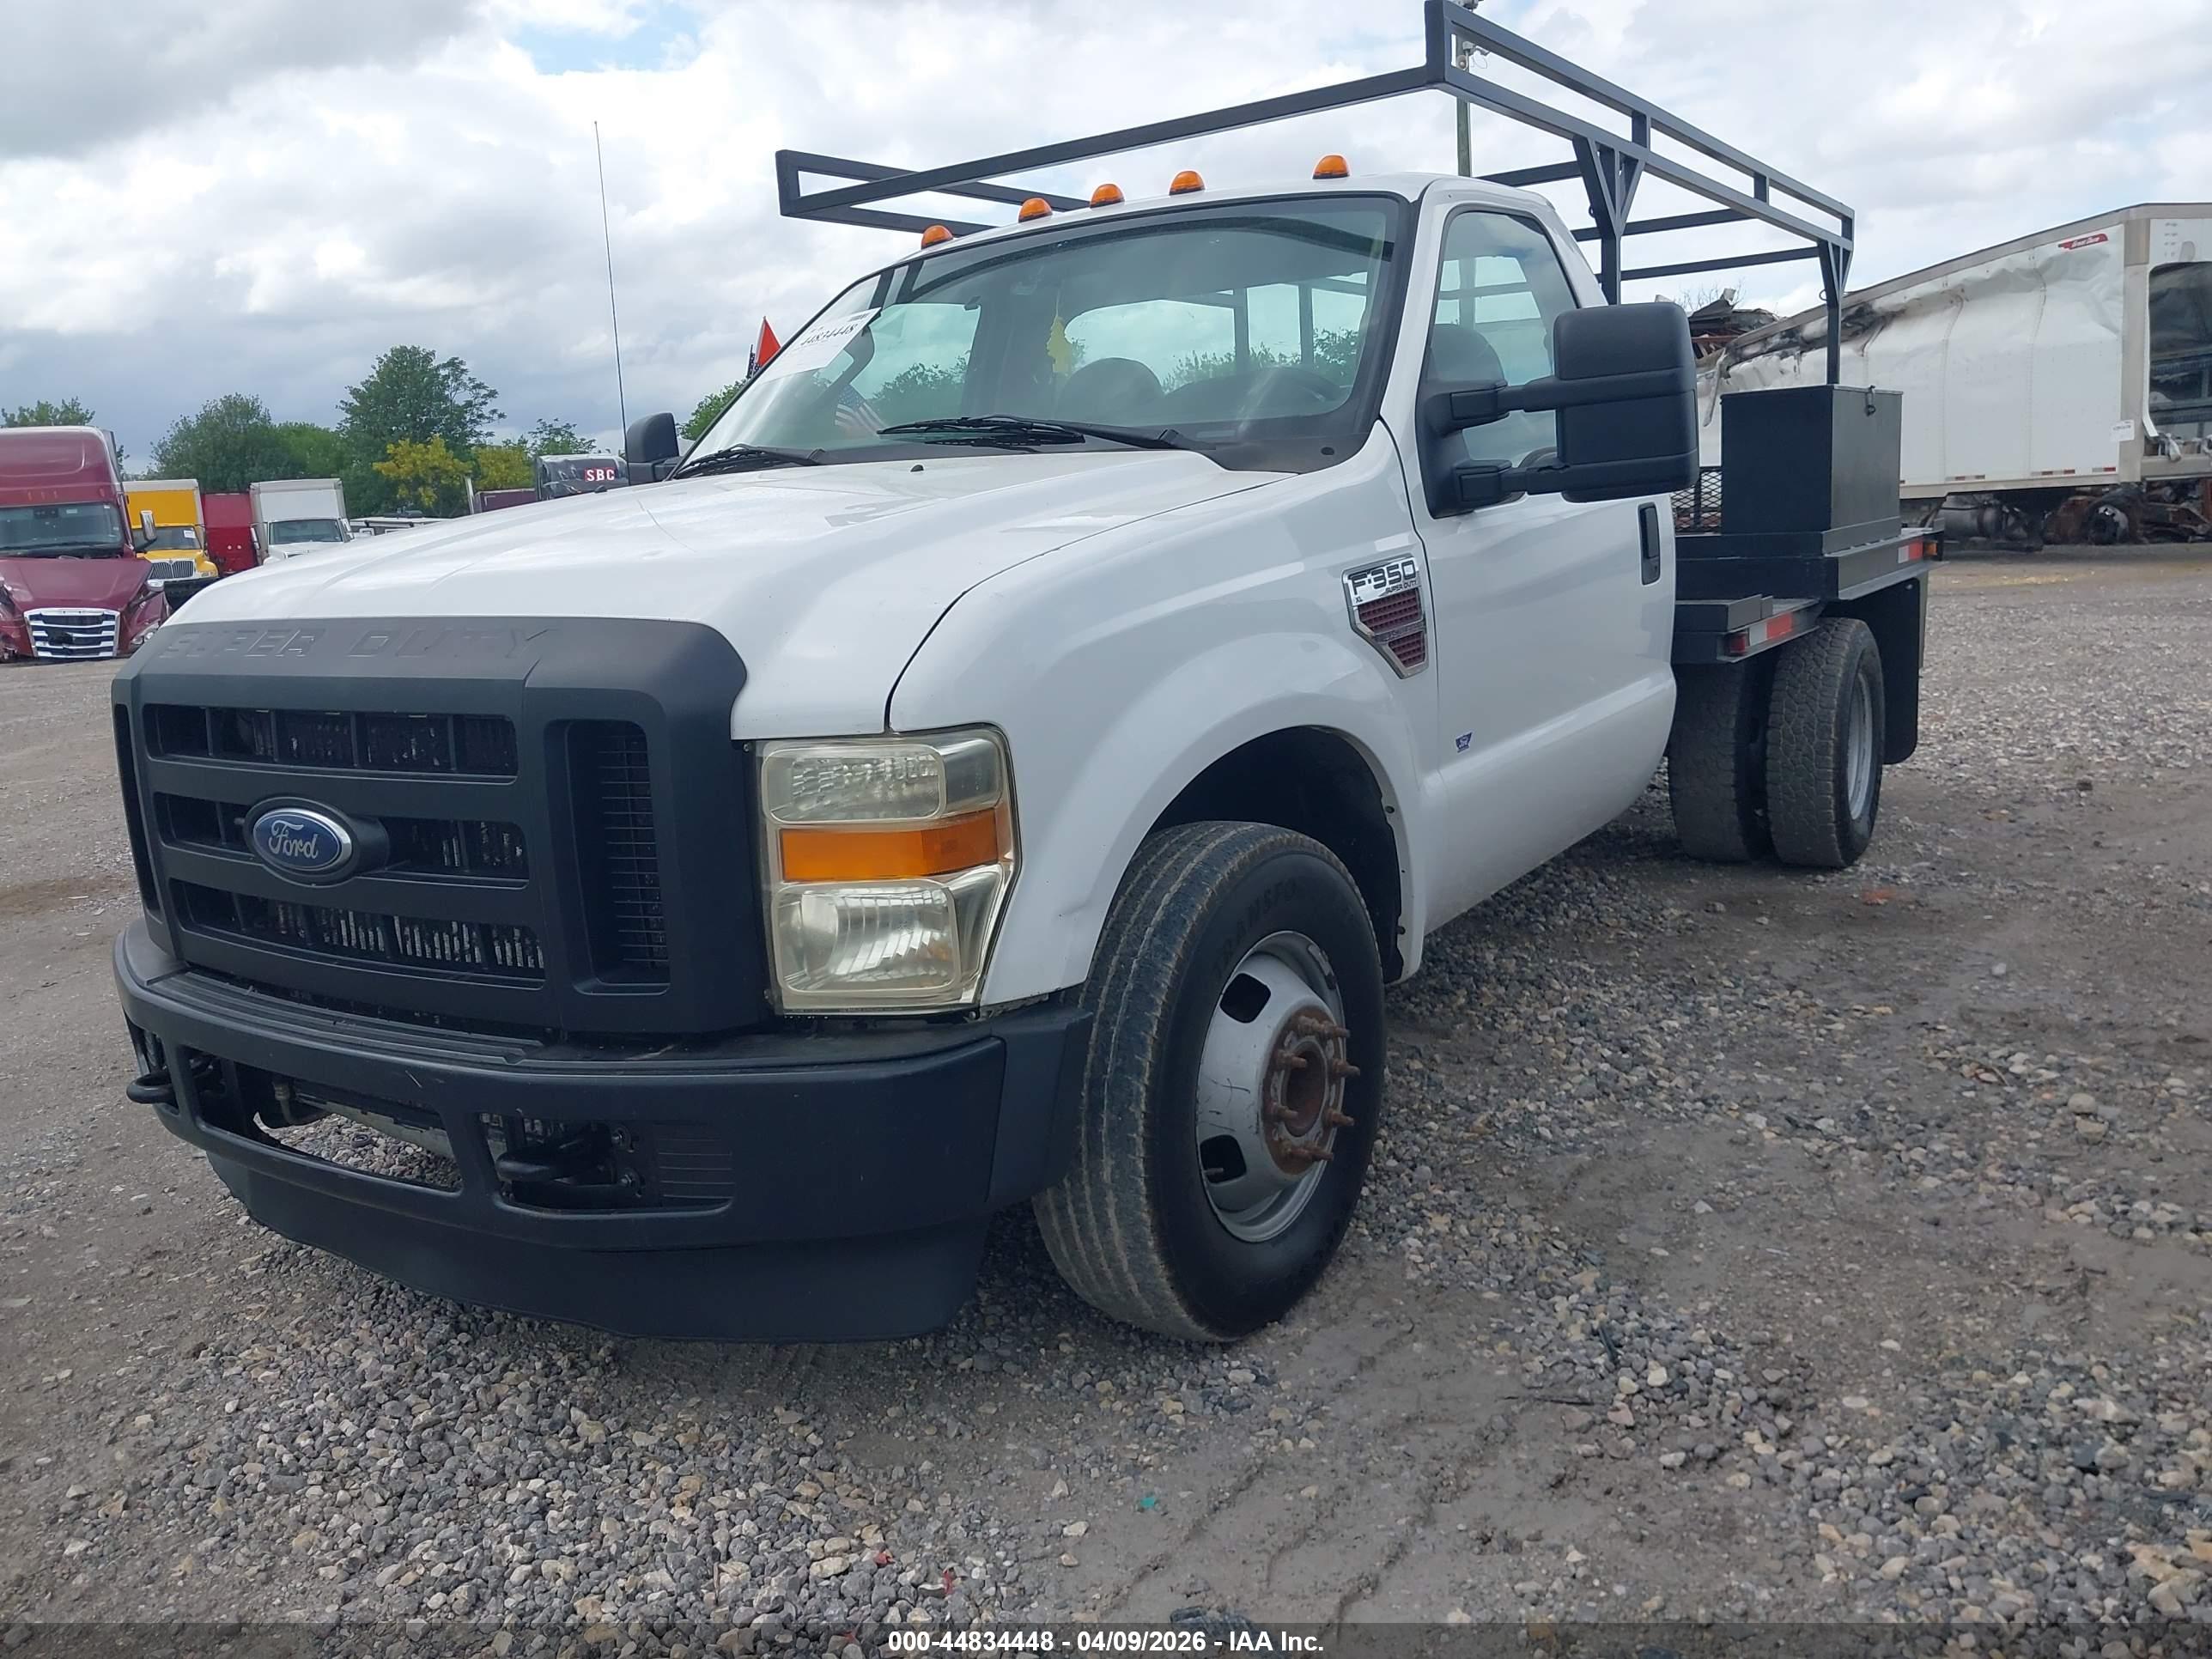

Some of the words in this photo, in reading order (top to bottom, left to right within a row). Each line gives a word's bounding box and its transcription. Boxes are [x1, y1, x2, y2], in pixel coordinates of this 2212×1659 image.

[586, 469, 615, 482] SBC
[1348, 560, 1417, 595] F-350
[1386, 585, 1404, 595] SUPER
[1404, 580, 1417, 590] DUTY
[158, 627, 328, 659] SUPER
[343, 626, 554, 659] DUTY
[268, 819, 319, 860] Ford
